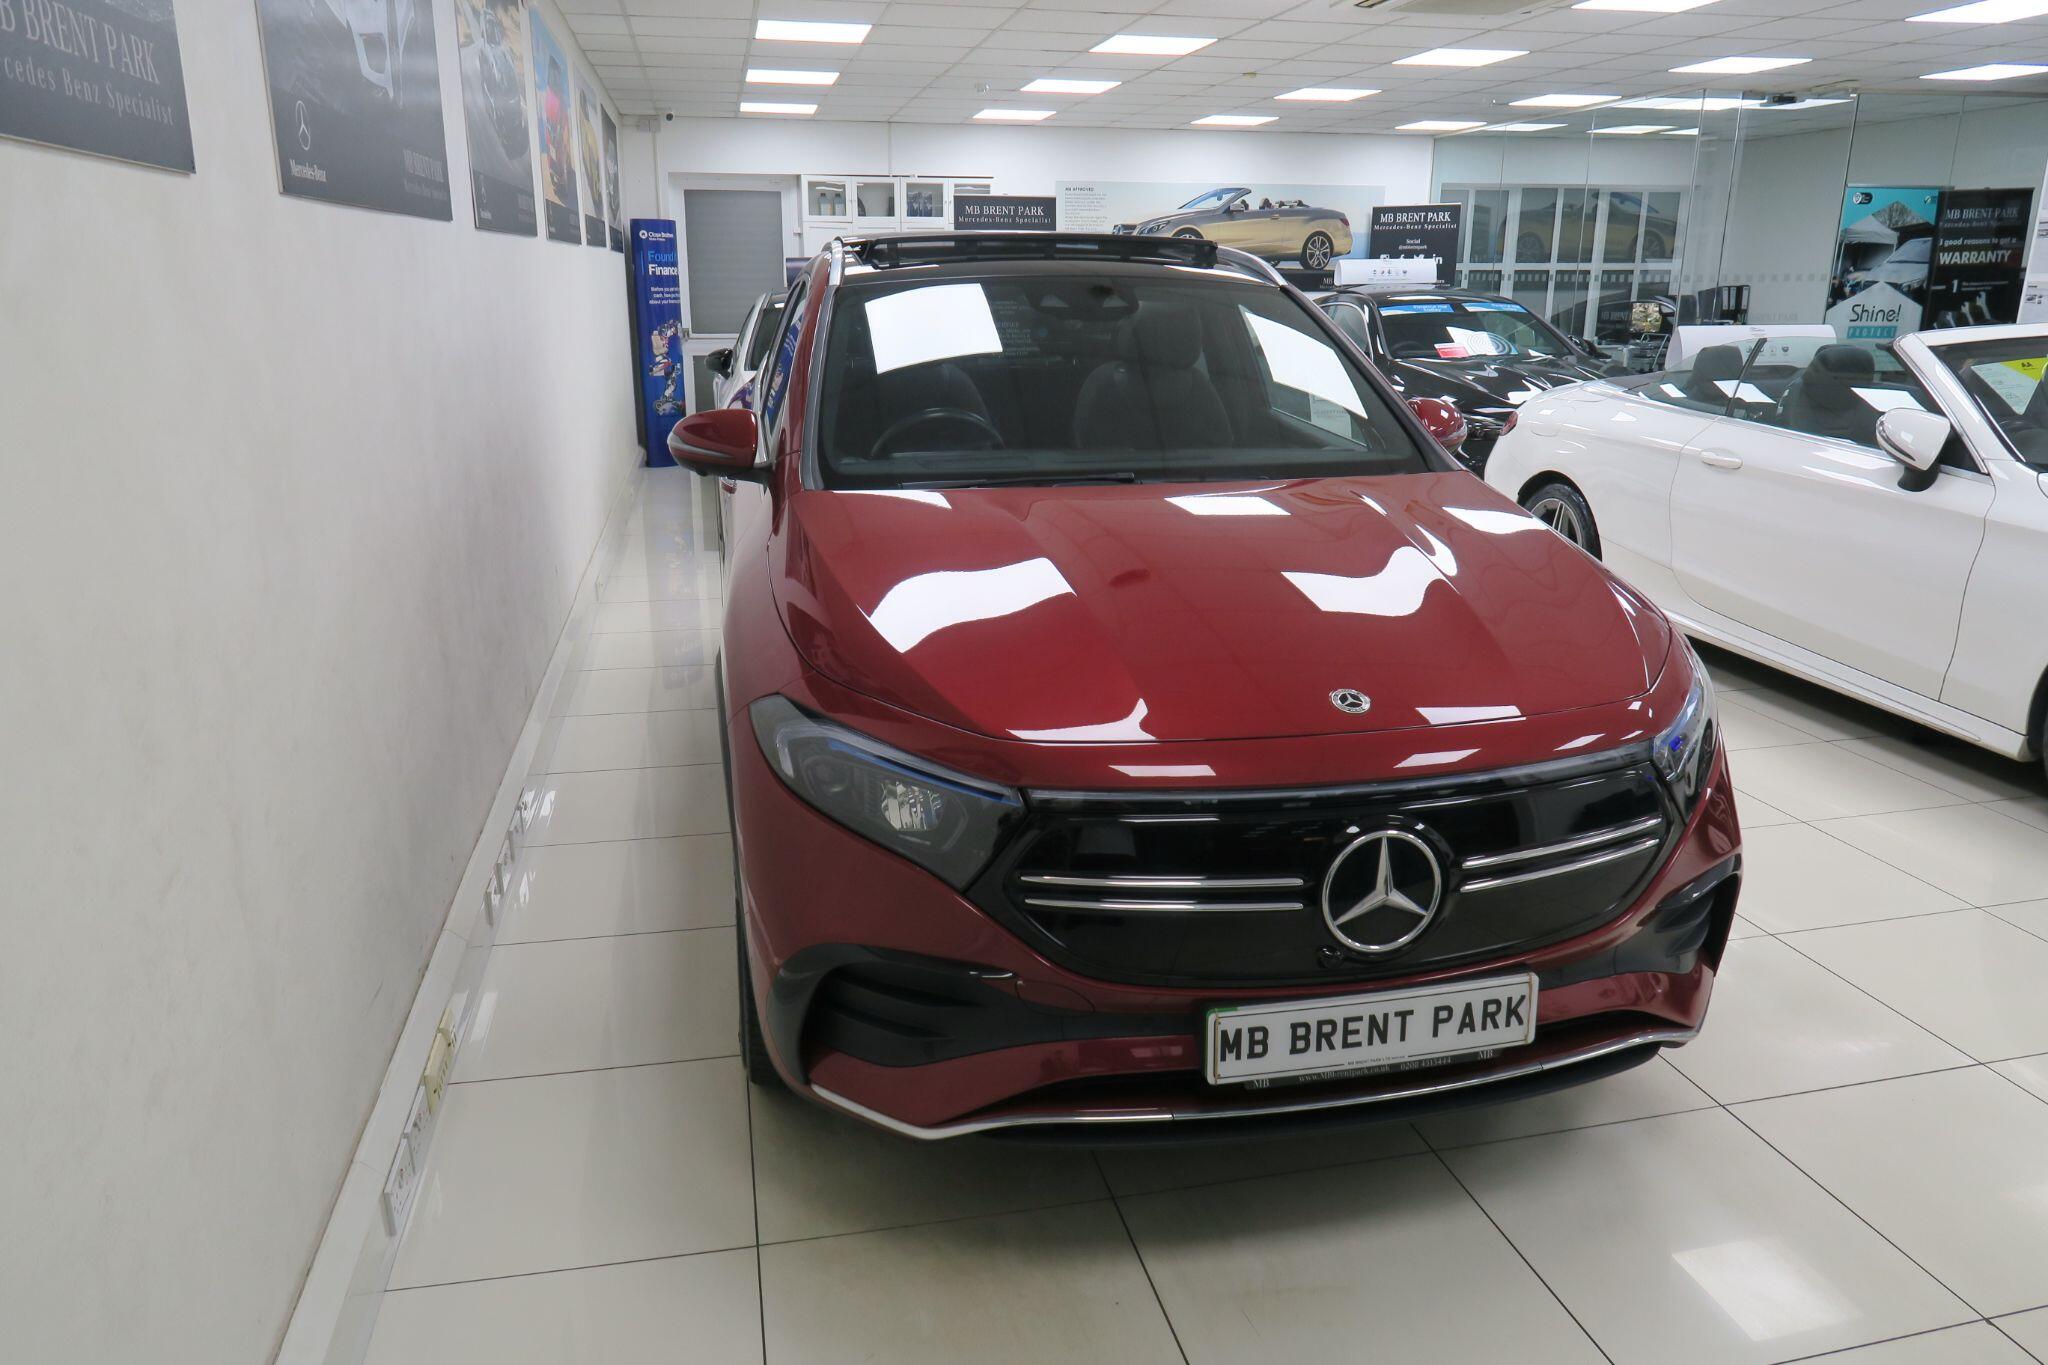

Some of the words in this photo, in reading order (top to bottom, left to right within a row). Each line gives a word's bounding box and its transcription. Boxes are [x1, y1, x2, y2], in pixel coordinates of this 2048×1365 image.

[22, 0, 100, 64] BRENT
[103, 22, 161, 85] PARK
[62, 67, 101, 105] Benz
[106, 82, 174, 126] Specialist
[965, 205, 981, 214] MB
[983, 205, 1016, 215] BRENT
[1018, 206, 1045, 216] PARK
[1945, 209, 1961, 220] MB
[1963, 208, 1993, 219] BRENT
[1993, 207, 2019, 218] PARK
[1015, 216, 1051, 224] Specialist
[1380, 213, 1394, 223] MB
[1396, 212, 1426, 223] BRENT
[1427, 211, 1451, 222] PARK
[1424, 223, 1457, 231] Specialist
[1944, 238, 1963, 247] good
[648, 250, 674, 262] Found
[1940, 250, 2012, 265] WARRANTY
[648, 264, 678, 276] Finance
[1952, 279, 1959, 293] 1
[1849, 304, 1902, 322] Shine!
[1850, 327, 1897, 338] PROTECT
[1219, 1026, 1269, 1062] MB
[1289, 1009, 1415, 1055] BRENT
[1432, 994, 1527, 1038] PARK
[1253, 1079, 1270, 1089] MB
[1478, 1049, 1493, 1060] MB
